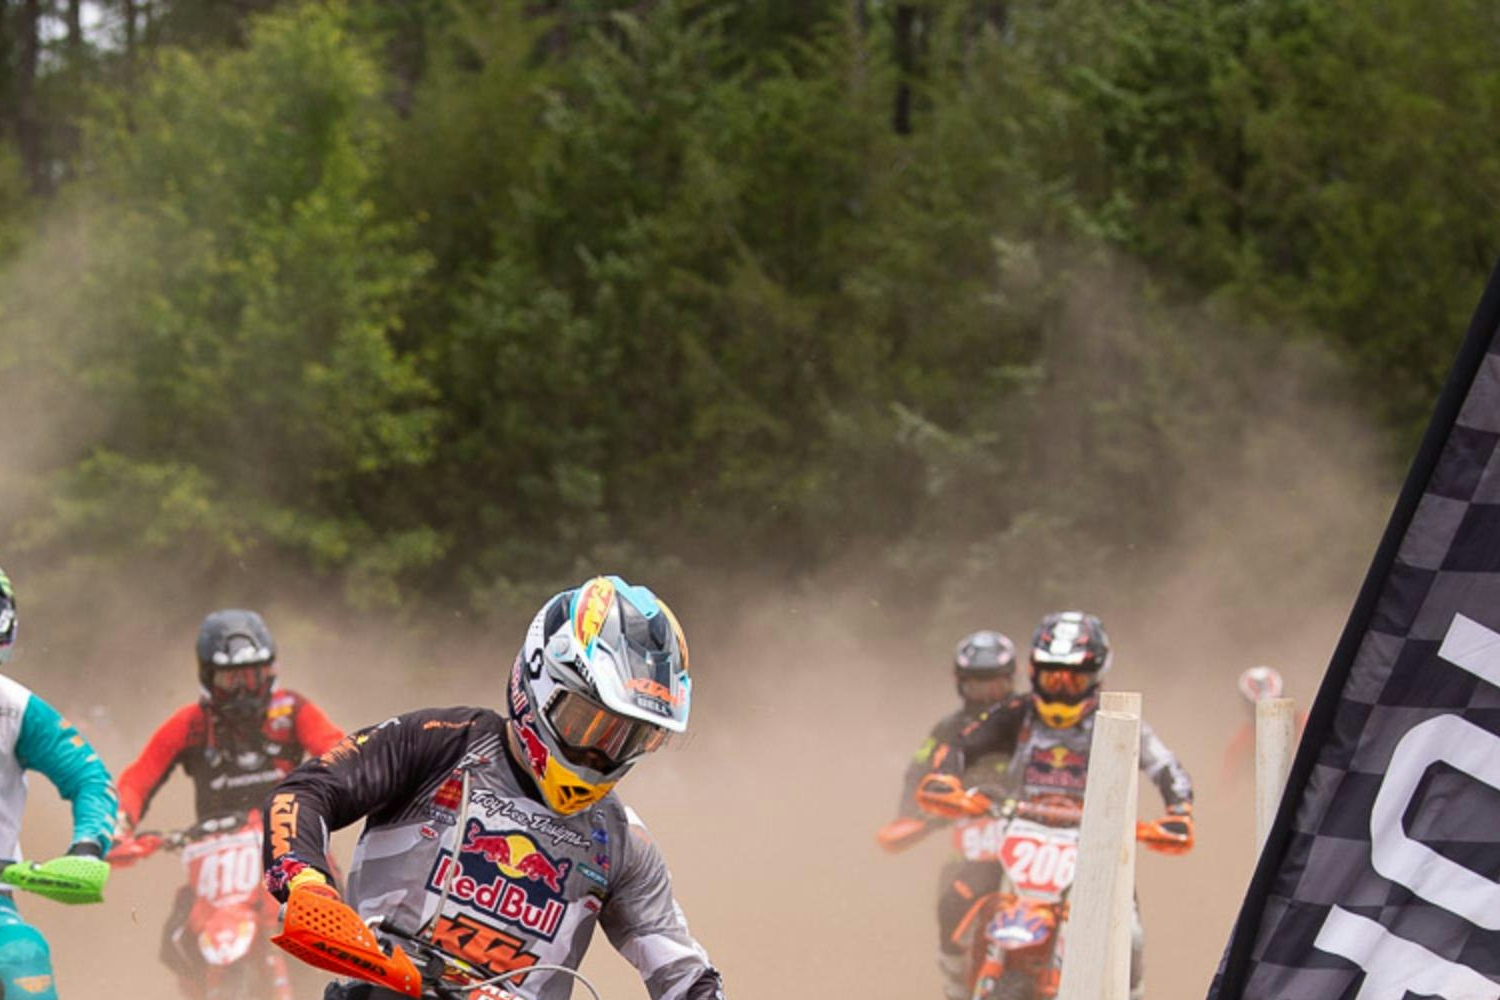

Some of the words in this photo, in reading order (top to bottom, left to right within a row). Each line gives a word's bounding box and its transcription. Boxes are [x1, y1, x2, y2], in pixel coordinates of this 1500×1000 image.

[269, 793, 299, 859] KTM
[469, 787, 502, 817] Troy
[501, 801, 529, 826] Lee
[528, 812, 592, 850] Designs
[434, 857, 503, 909] Red
[499, 880, 564, 936] Bull
[1012, 839, 1079, 890] 206
[312, 939, 388, 978] ACERBIS
[427, 914, 540, 986] KTM
